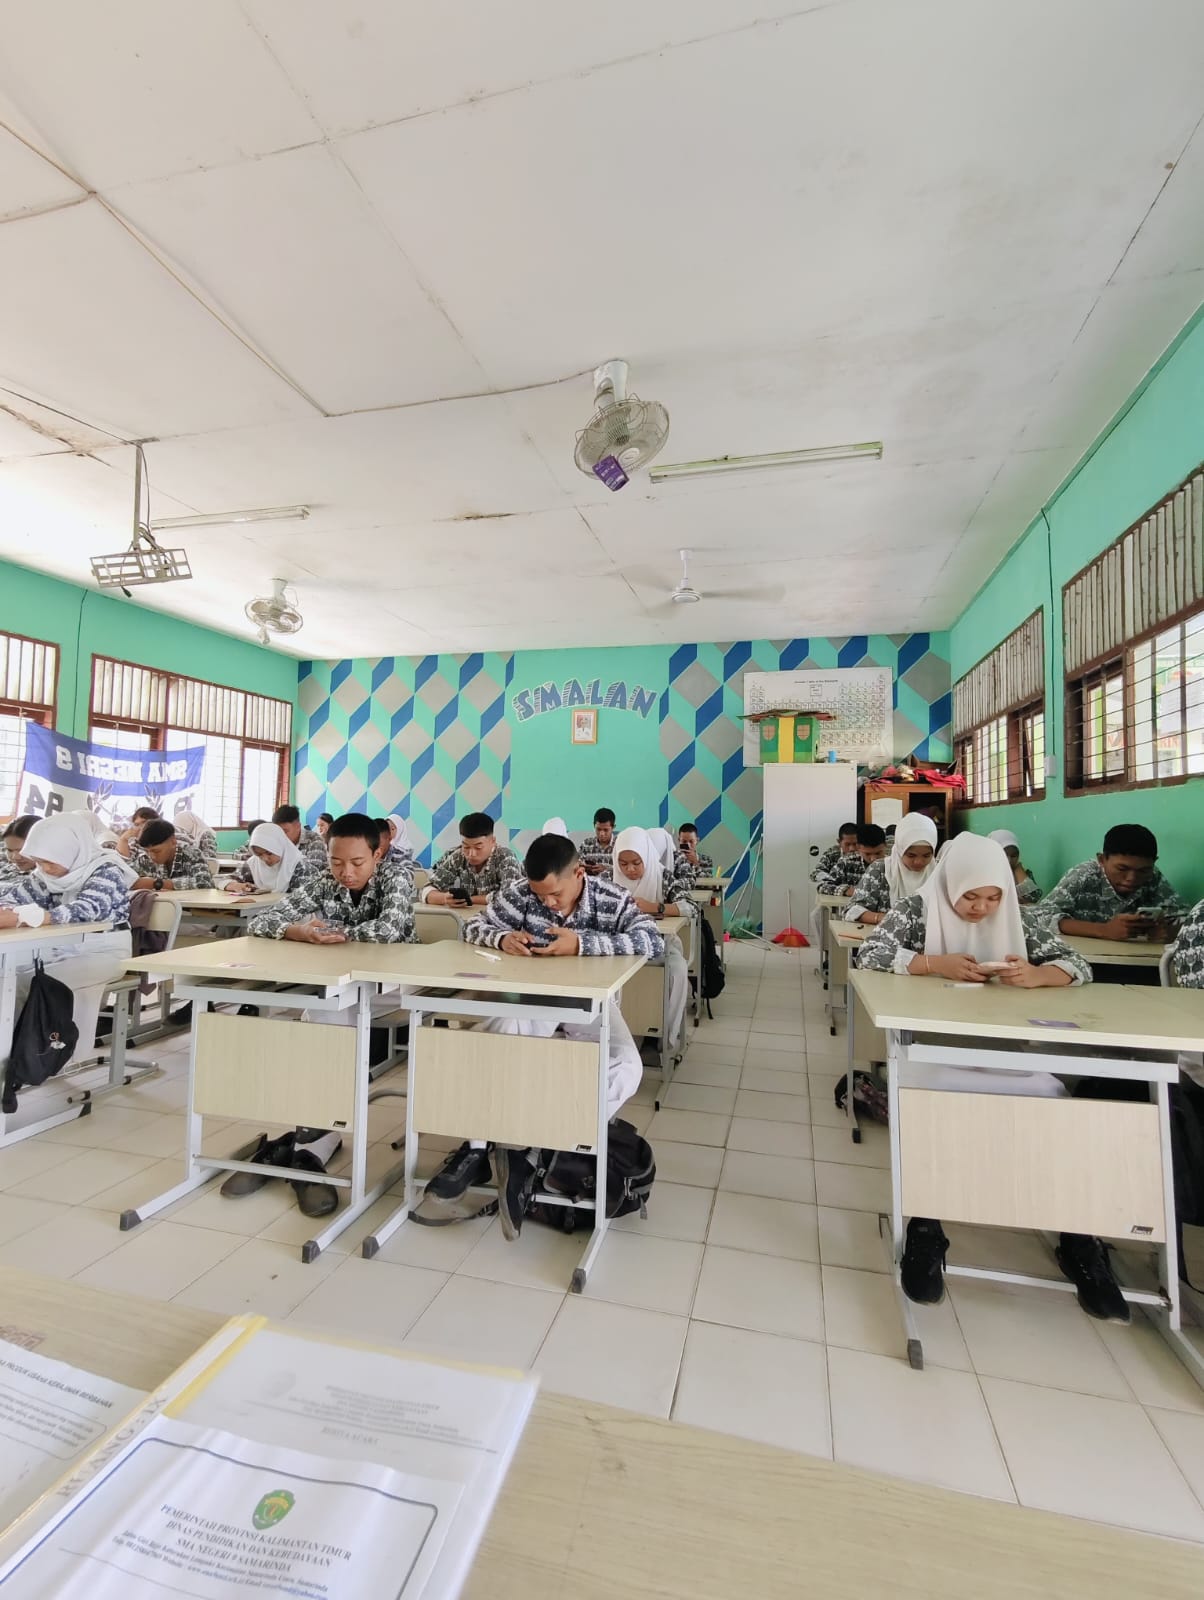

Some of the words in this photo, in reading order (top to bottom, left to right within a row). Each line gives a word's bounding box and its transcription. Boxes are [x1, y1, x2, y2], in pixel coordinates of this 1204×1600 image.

[513, 679, 657, 722] SMALAN
[161, 1503, 218, 1530] PEMERINTAH
[217, 1523, 259, 1541] PROVINSI
[260, 1534, 319, 1551] KALIMANTAN
[320, 1543, 352, 1561] TIMUR
[166, 1520, 192, 1535] DINAS
[193, 1529, 247, 1553] PENDIDIKAN
[248, 1545, 267, 1556] DAN
[267, 1547, 332, 1568] KEBUDAYAAN
[176, 1538, 195, 1551] SMA
[199, 1544, 231, 1560] NEGERI
[239, 1557, 292, 1573] SAMARINDA
